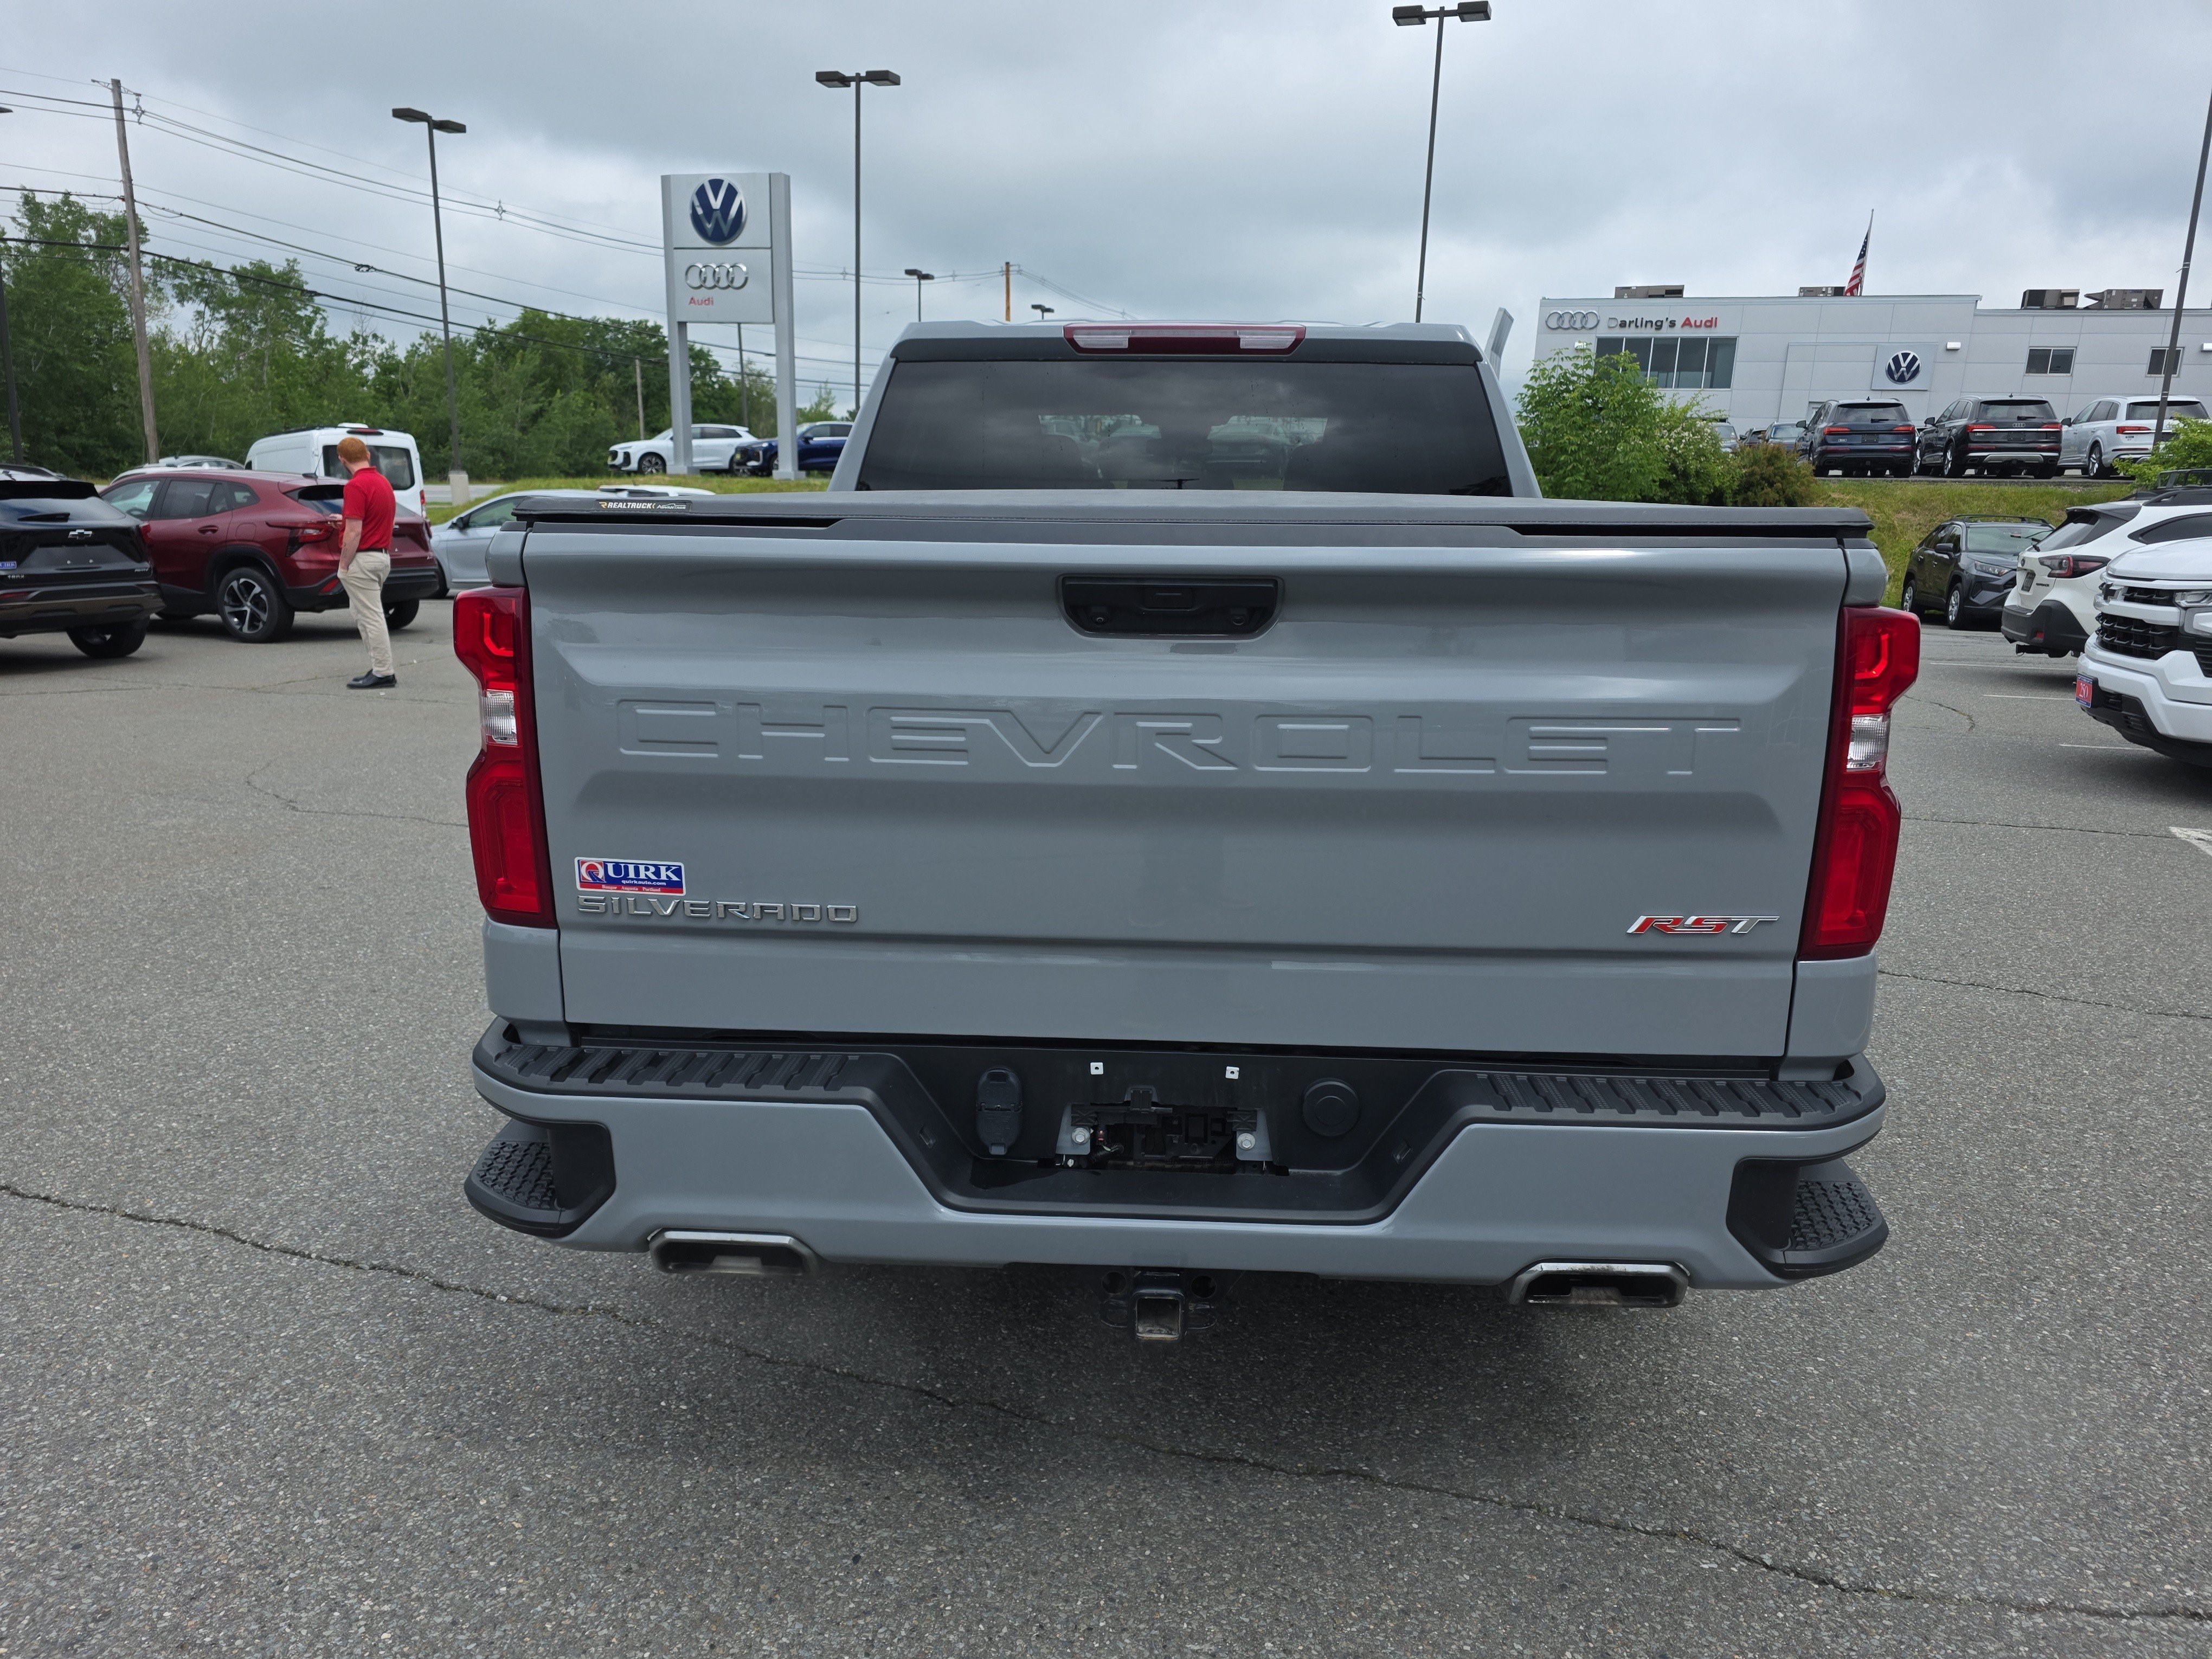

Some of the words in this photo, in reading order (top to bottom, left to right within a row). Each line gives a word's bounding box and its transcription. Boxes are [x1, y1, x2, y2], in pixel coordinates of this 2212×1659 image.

[688, 296, 715, 306] Audi
[1607, 317, 1676, 331] Darling's
[1681, 317, 1718, 329] Audi
[616, 698, 1741, 774] CHEVROLET
[581, 861, 681, 883] QUIRK
[577, 895, 859, 922] SILVERADO
[1626, 915, 1780, 934] RST
